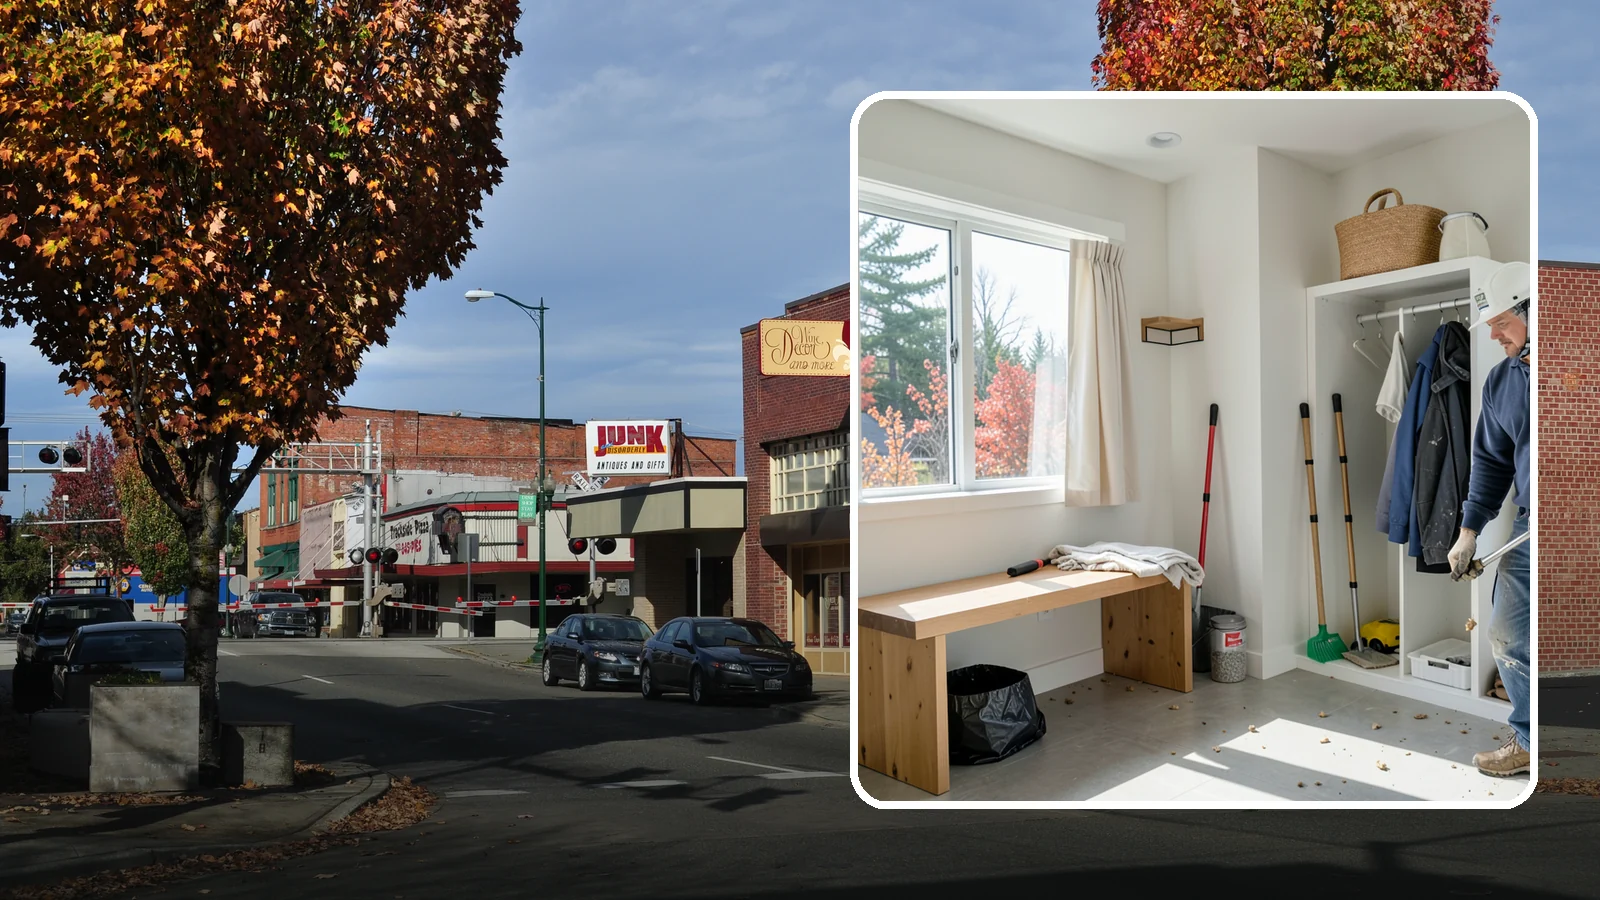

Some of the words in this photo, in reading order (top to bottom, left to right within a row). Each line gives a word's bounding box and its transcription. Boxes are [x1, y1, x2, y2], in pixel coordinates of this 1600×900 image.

[765, 328, 831, 365] Decor
[596, 425, 664, 457] JUNK
[607, 446, 646, 454] DISORDERLY
[596, 461, 628, 470] ANTIQUES
[631, 461, 644, 470] AND
[646, 460, 665, 469] GIFTS
